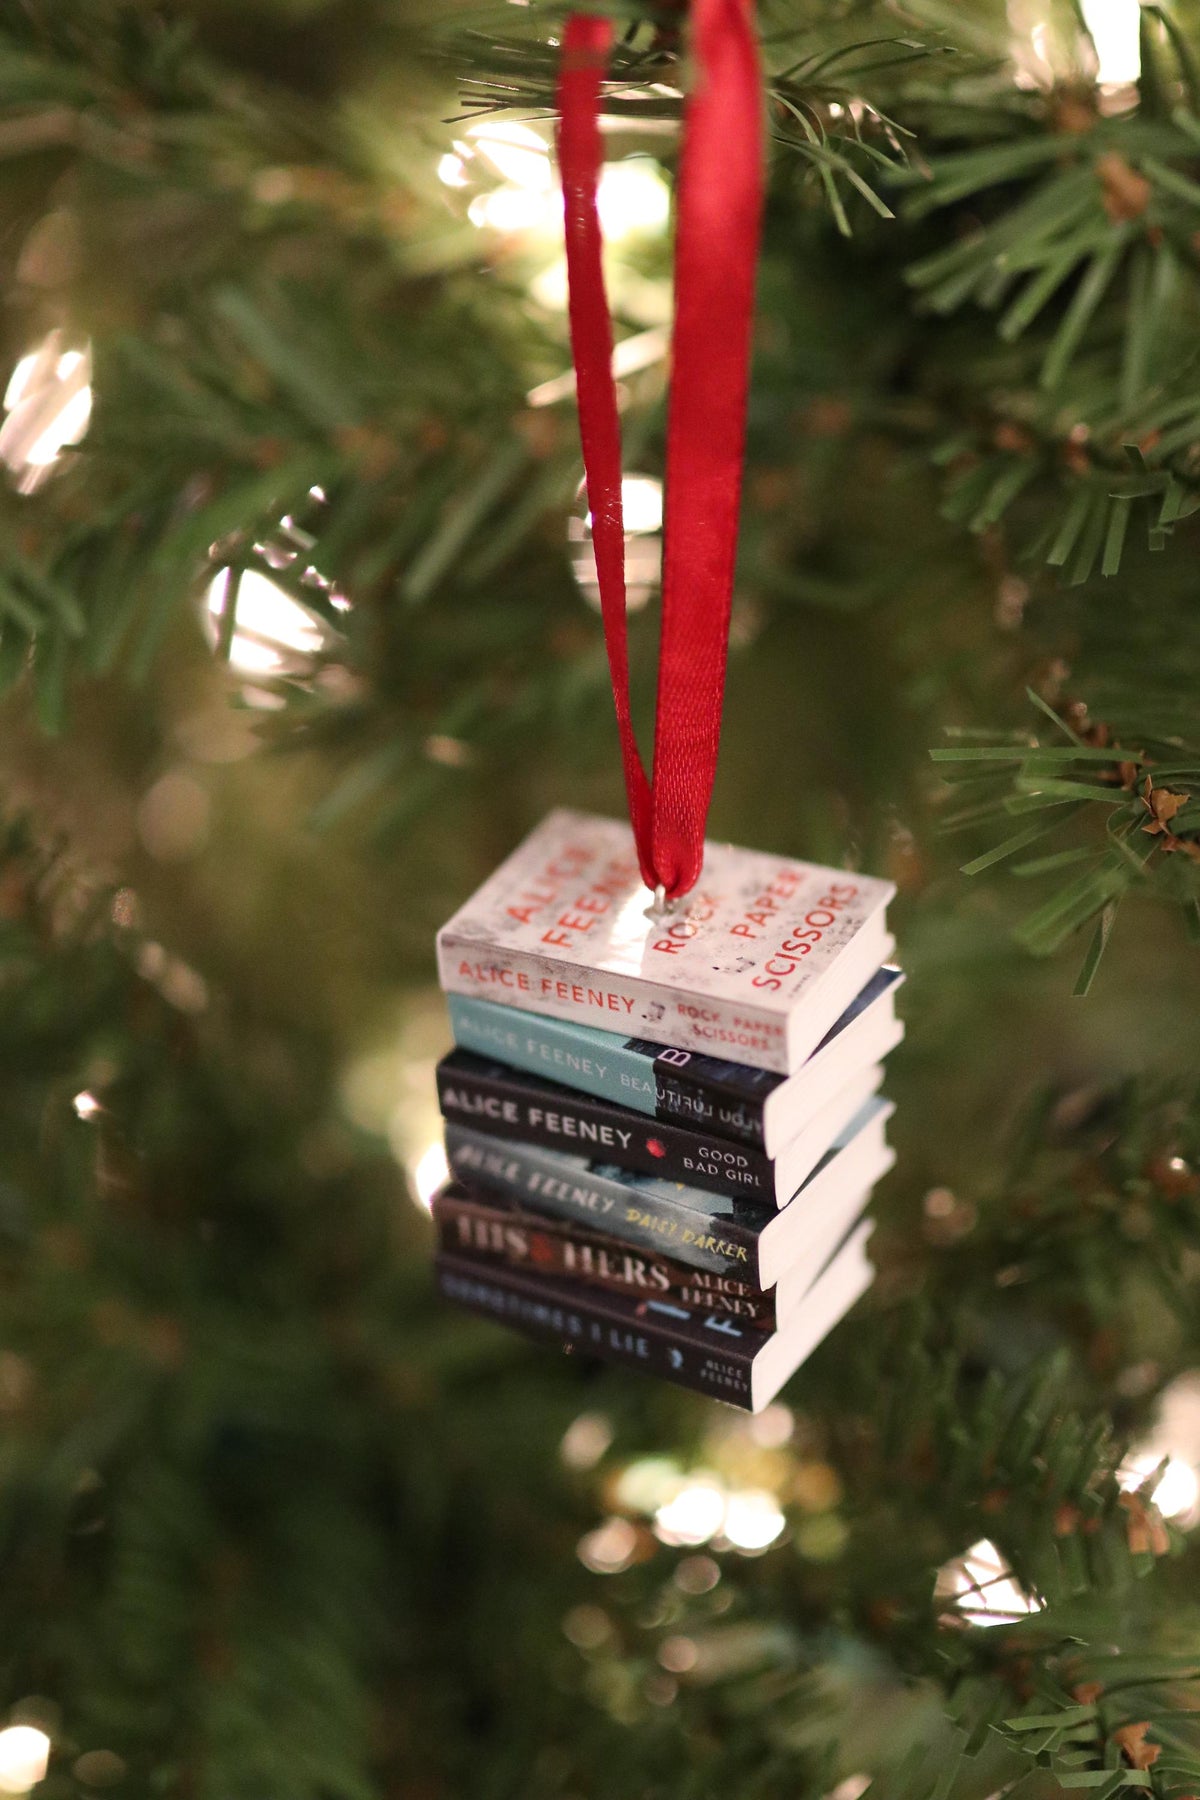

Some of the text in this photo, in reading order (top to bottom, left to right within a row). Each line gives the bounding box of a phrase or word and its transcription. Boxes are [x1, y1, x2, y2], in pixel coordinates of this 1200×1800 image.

[505, 845, 596, 925] ALICE
[752, 884, 859, 991] SCISSORS
[458, 960, 636, 1014] ALICE FEENEY
[677, 1003, 720, 1022] ROCK
[459, 1016, 607, 1079] ALICE FEENEY
[692, 1023, 769, 1050] SCISSORS
[442, 1087, 632, 1149] ALICE FEENEY
[683, 1157, 762, 1187] BAD GIRL
[698, 1147, 749, 1168] GOOD
[526, 1171, 615, 1214] FEENEY
[625, 1208, 678, 1237] DAISY
[681, 1229, 748, 1262] DARKER
[563, 1241, 671, 1292] HERS
[691, 1272, 750, 1297] ALICE
[681, 1286, 760, 1318] FEENEY
[609, 1328, 649, 1359] LIE
